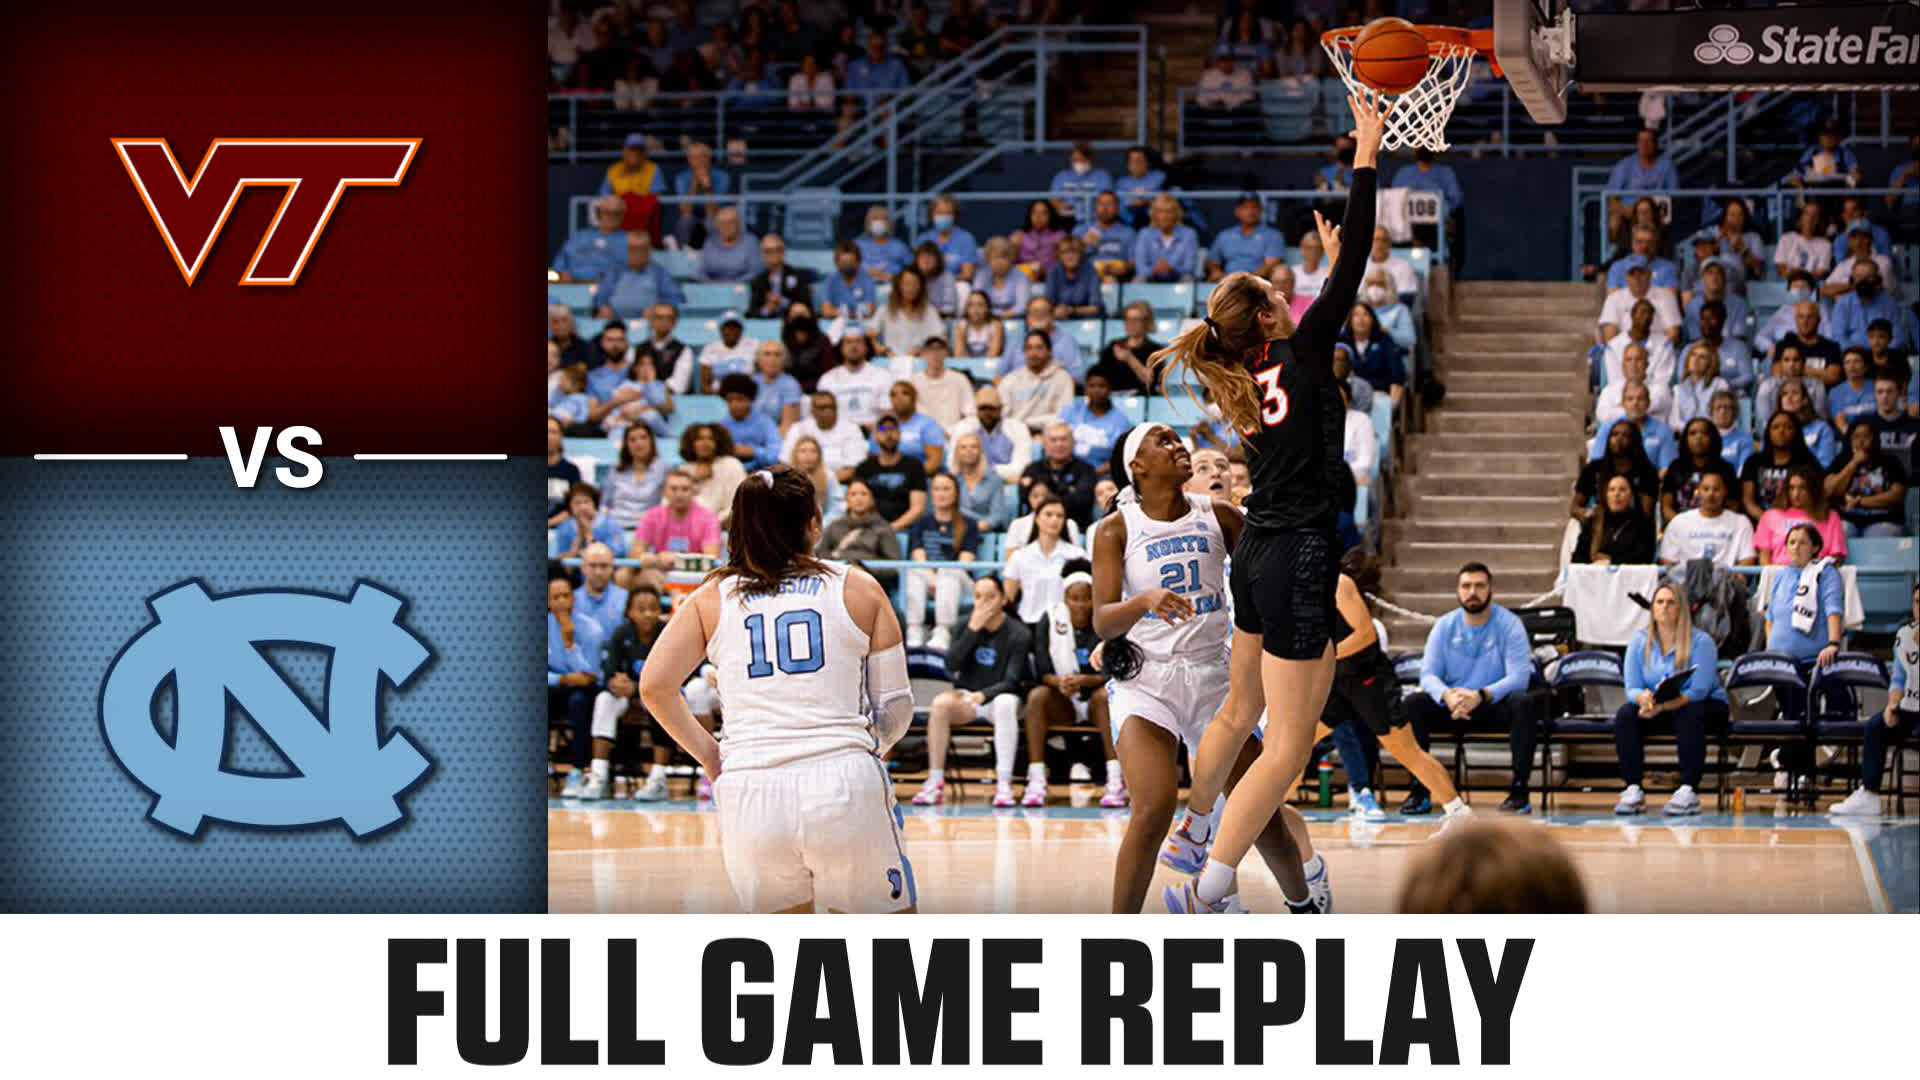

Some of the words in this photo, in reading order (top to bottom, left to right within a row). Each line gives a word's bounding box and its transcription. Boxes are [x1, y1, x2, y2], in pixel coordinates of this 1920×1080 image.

[1408, 199, 1437, 217] 108
[1145, 535, 1210, 562] NORTH
[1160, 560, 1202, 594] 21
[744, 608, 825, 679] 10
[1736, 658, 1797, 675] CAROLINA
